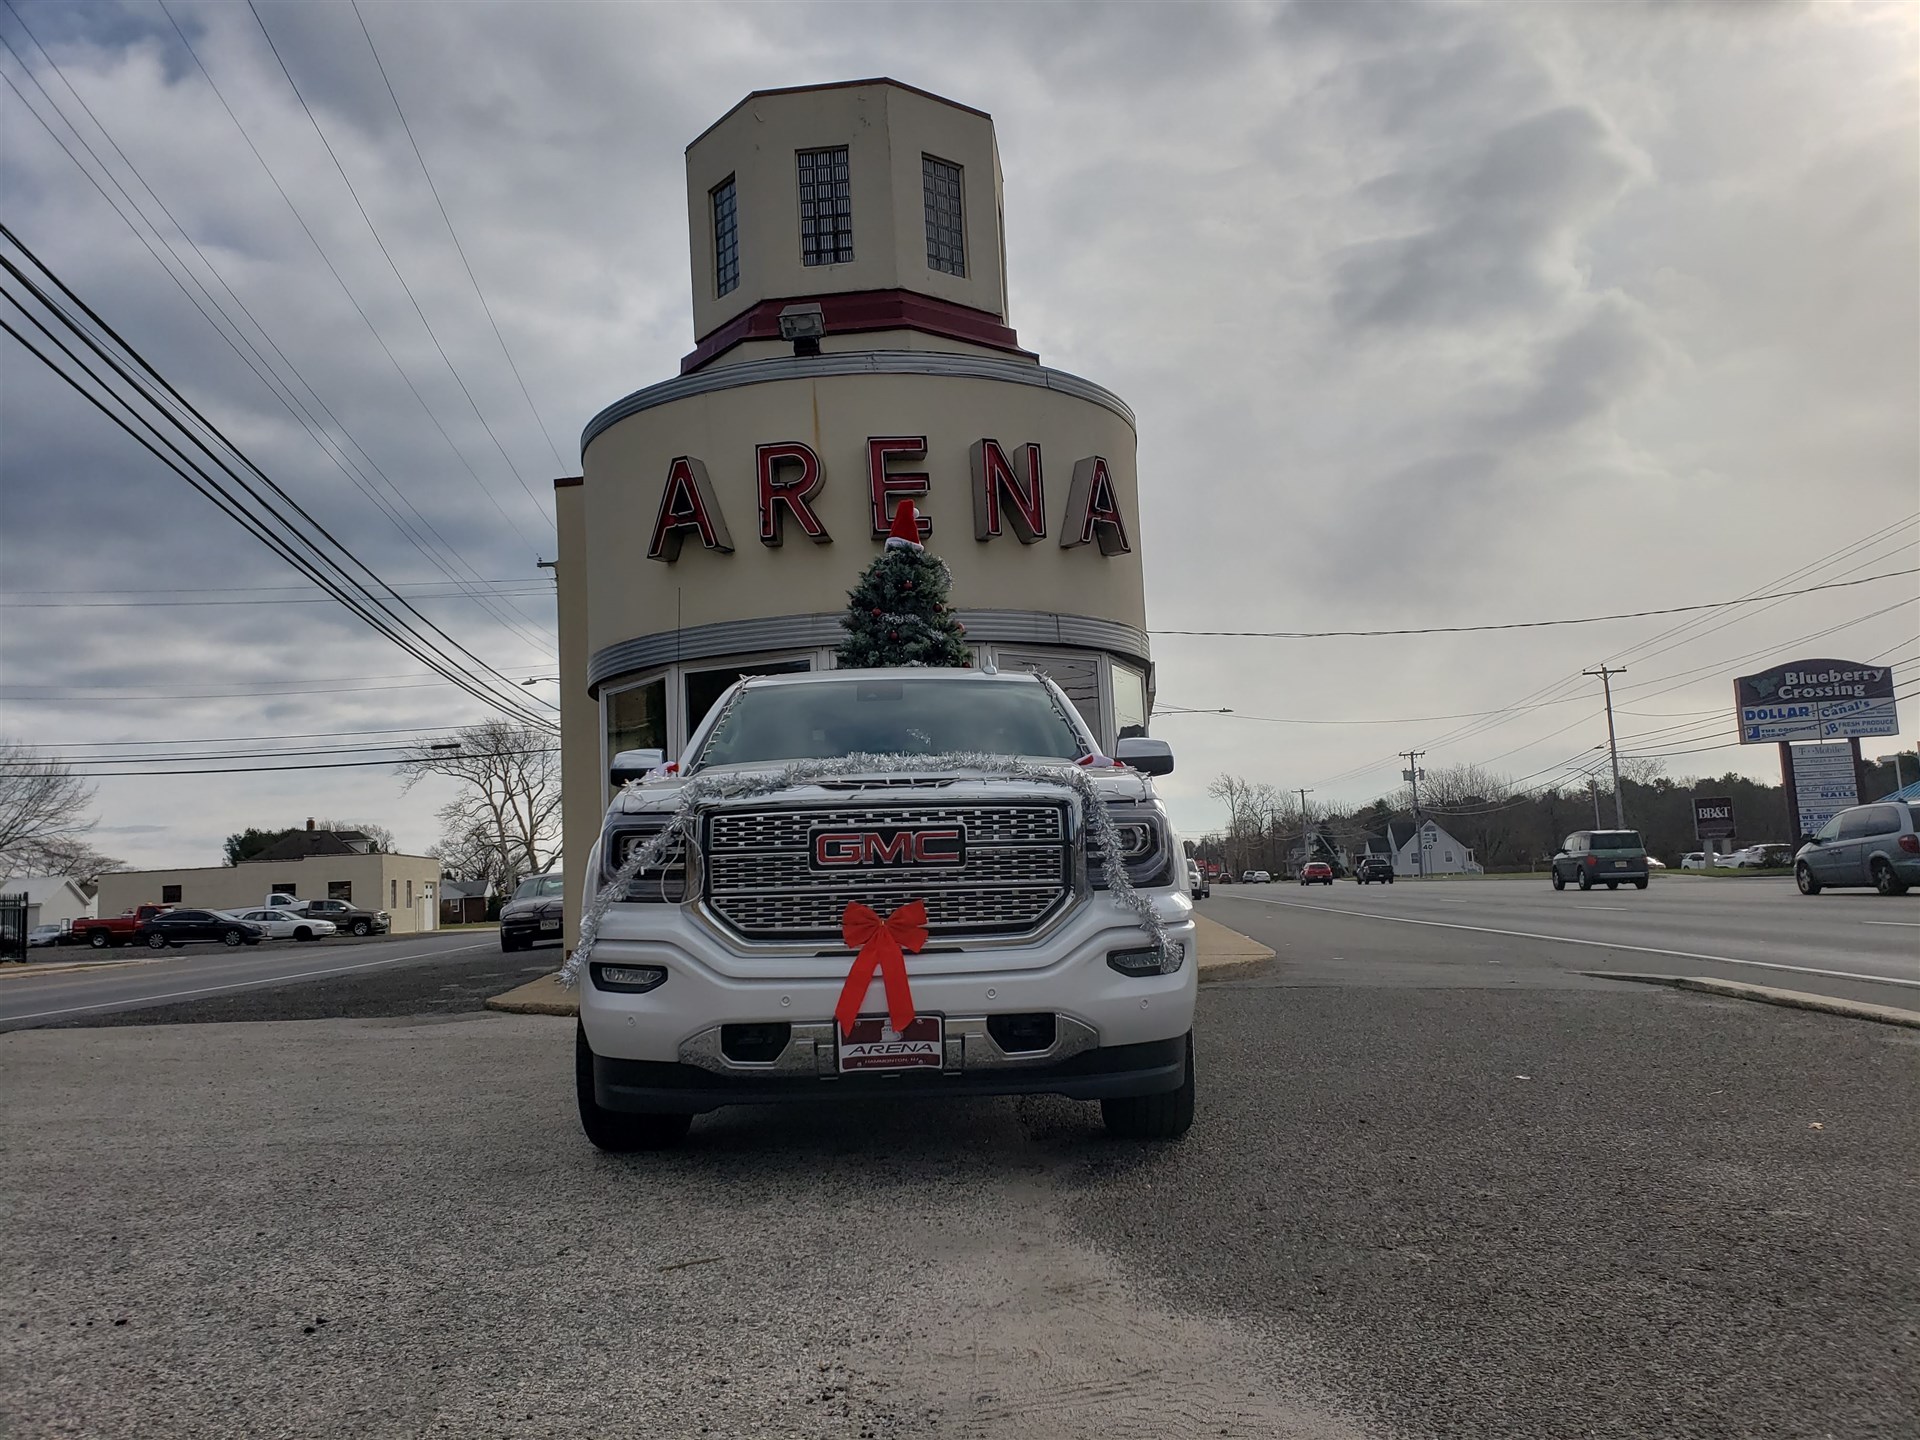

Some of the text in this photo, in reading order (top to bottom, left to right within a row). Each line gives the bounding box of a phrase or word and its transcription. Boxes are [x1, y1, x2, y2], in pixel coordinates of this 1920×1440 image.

[647, 435, 1131, 563] ARENA
[1785, 669, 1884, 685] Blueberry
[1778, 682, 1866, 699] Crossing
[1744, 706, 1810, 721] DOLLAR
[1821, 700, 1871, 717] Canal's
[1824, 722, 1838, 736] JB
[1850, 726, 1892, 735] WHOLESALE
[1698, 806, 1730, 819] BB&T
[816, 830, 960, 865] GMC
[848, 1043, 934, 1056] ARENA
